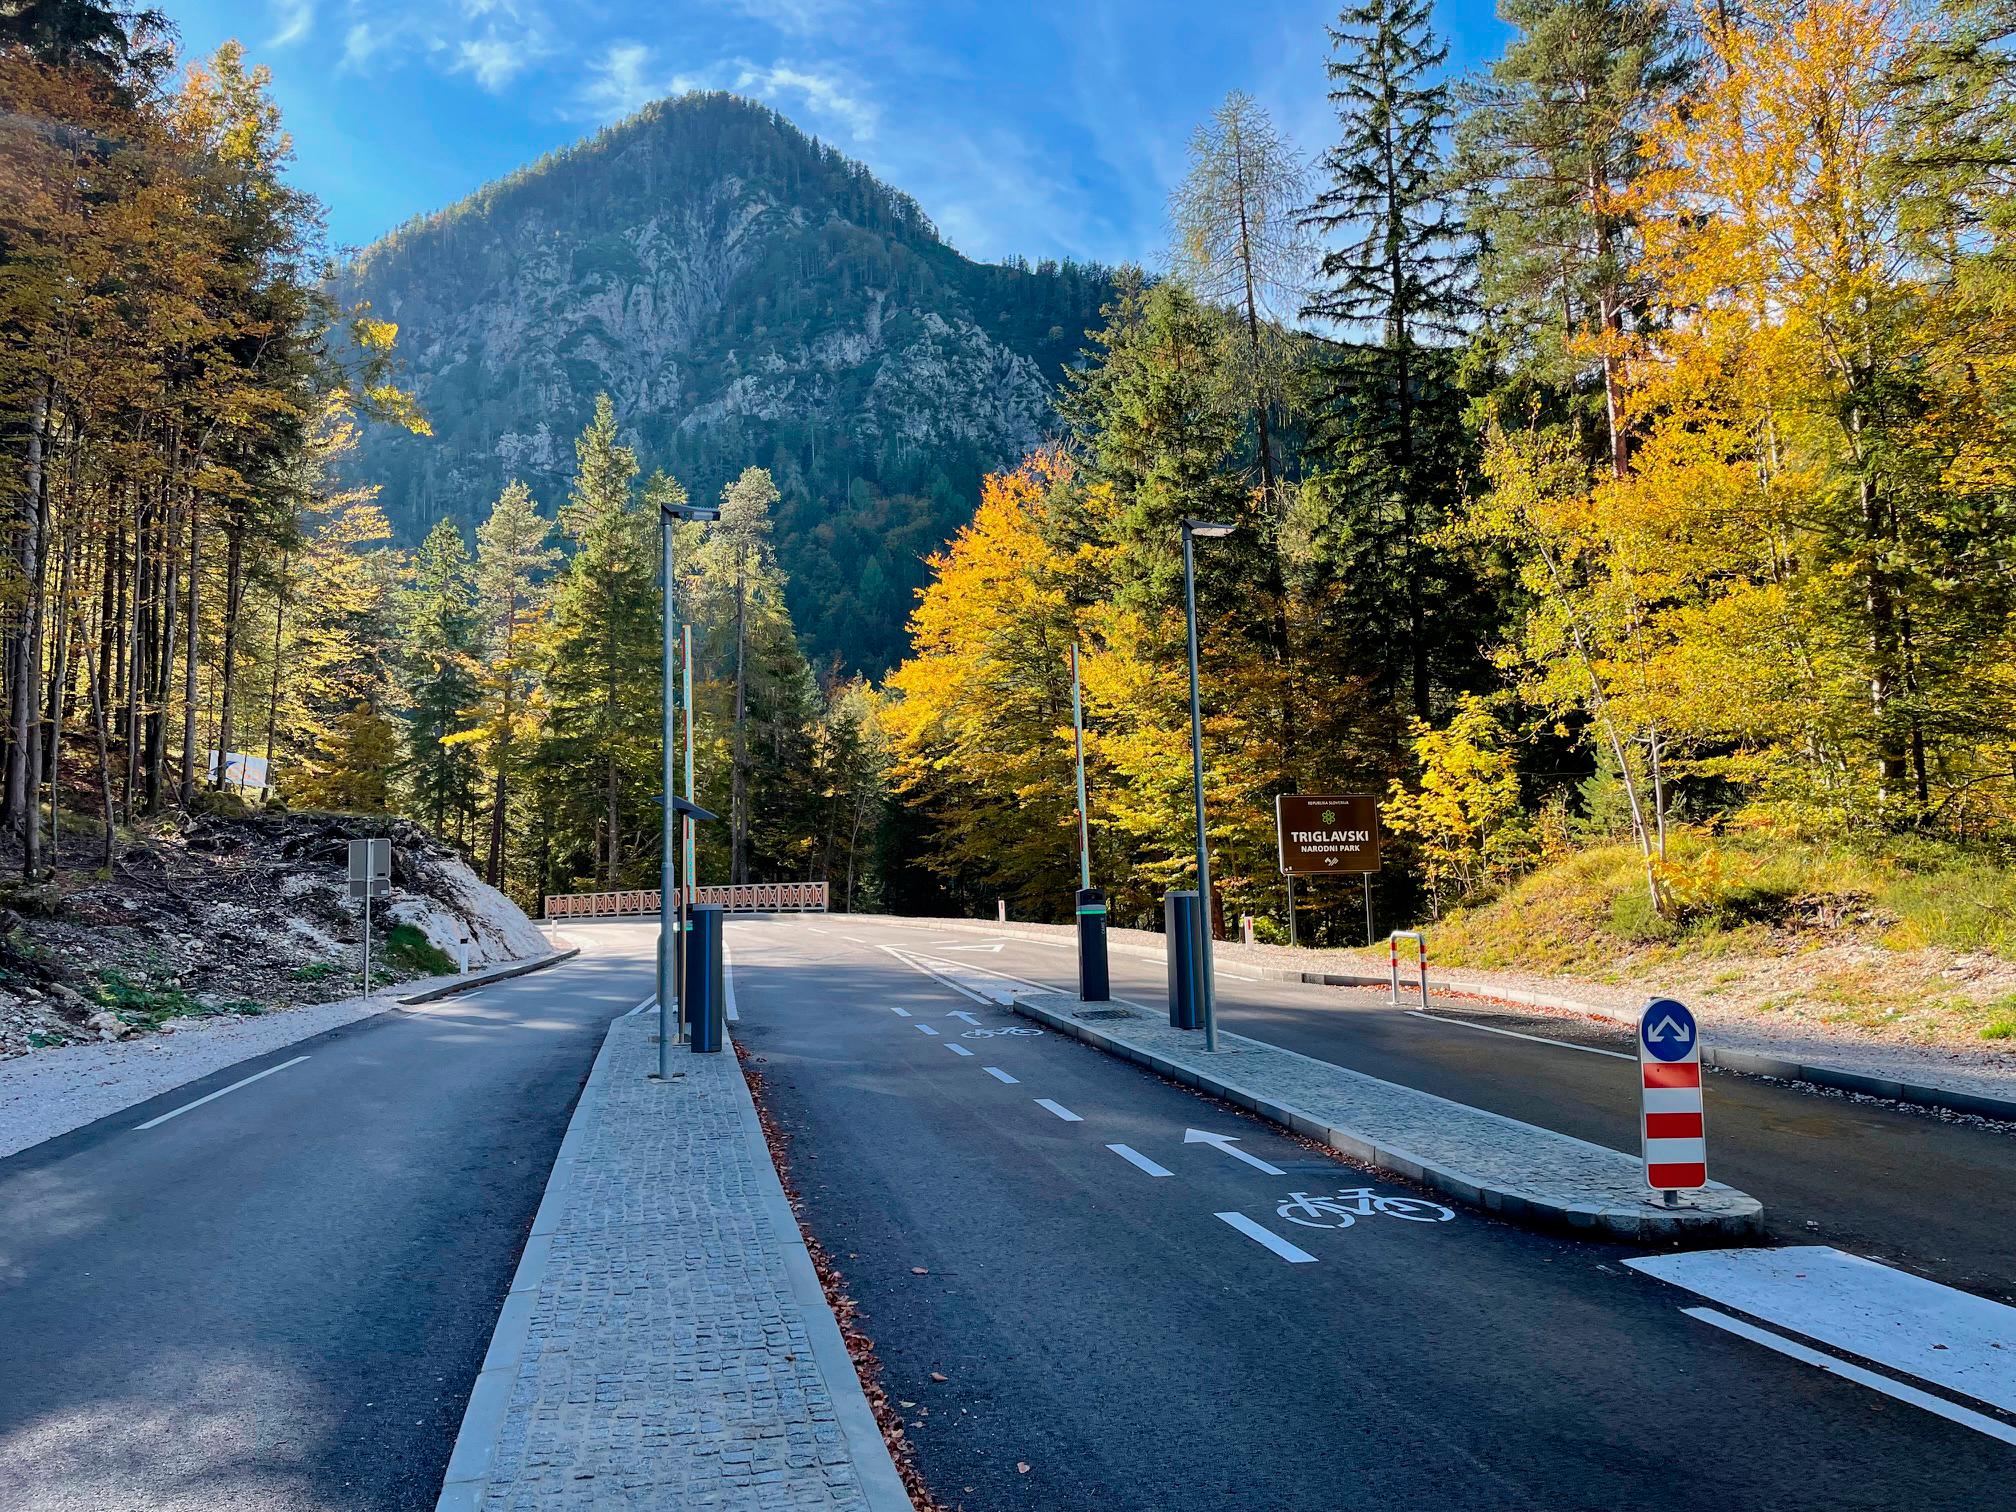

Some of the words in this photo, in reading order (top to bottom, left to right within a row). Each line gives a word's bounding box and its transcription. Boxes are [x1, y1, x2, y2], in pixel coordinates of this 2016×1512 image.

[1290, 830, 1369, 843] TRIGLAVSKI
[1301, 845, 1338, 853] NARODNI
[1339, 844, 1361, 852] PARK
